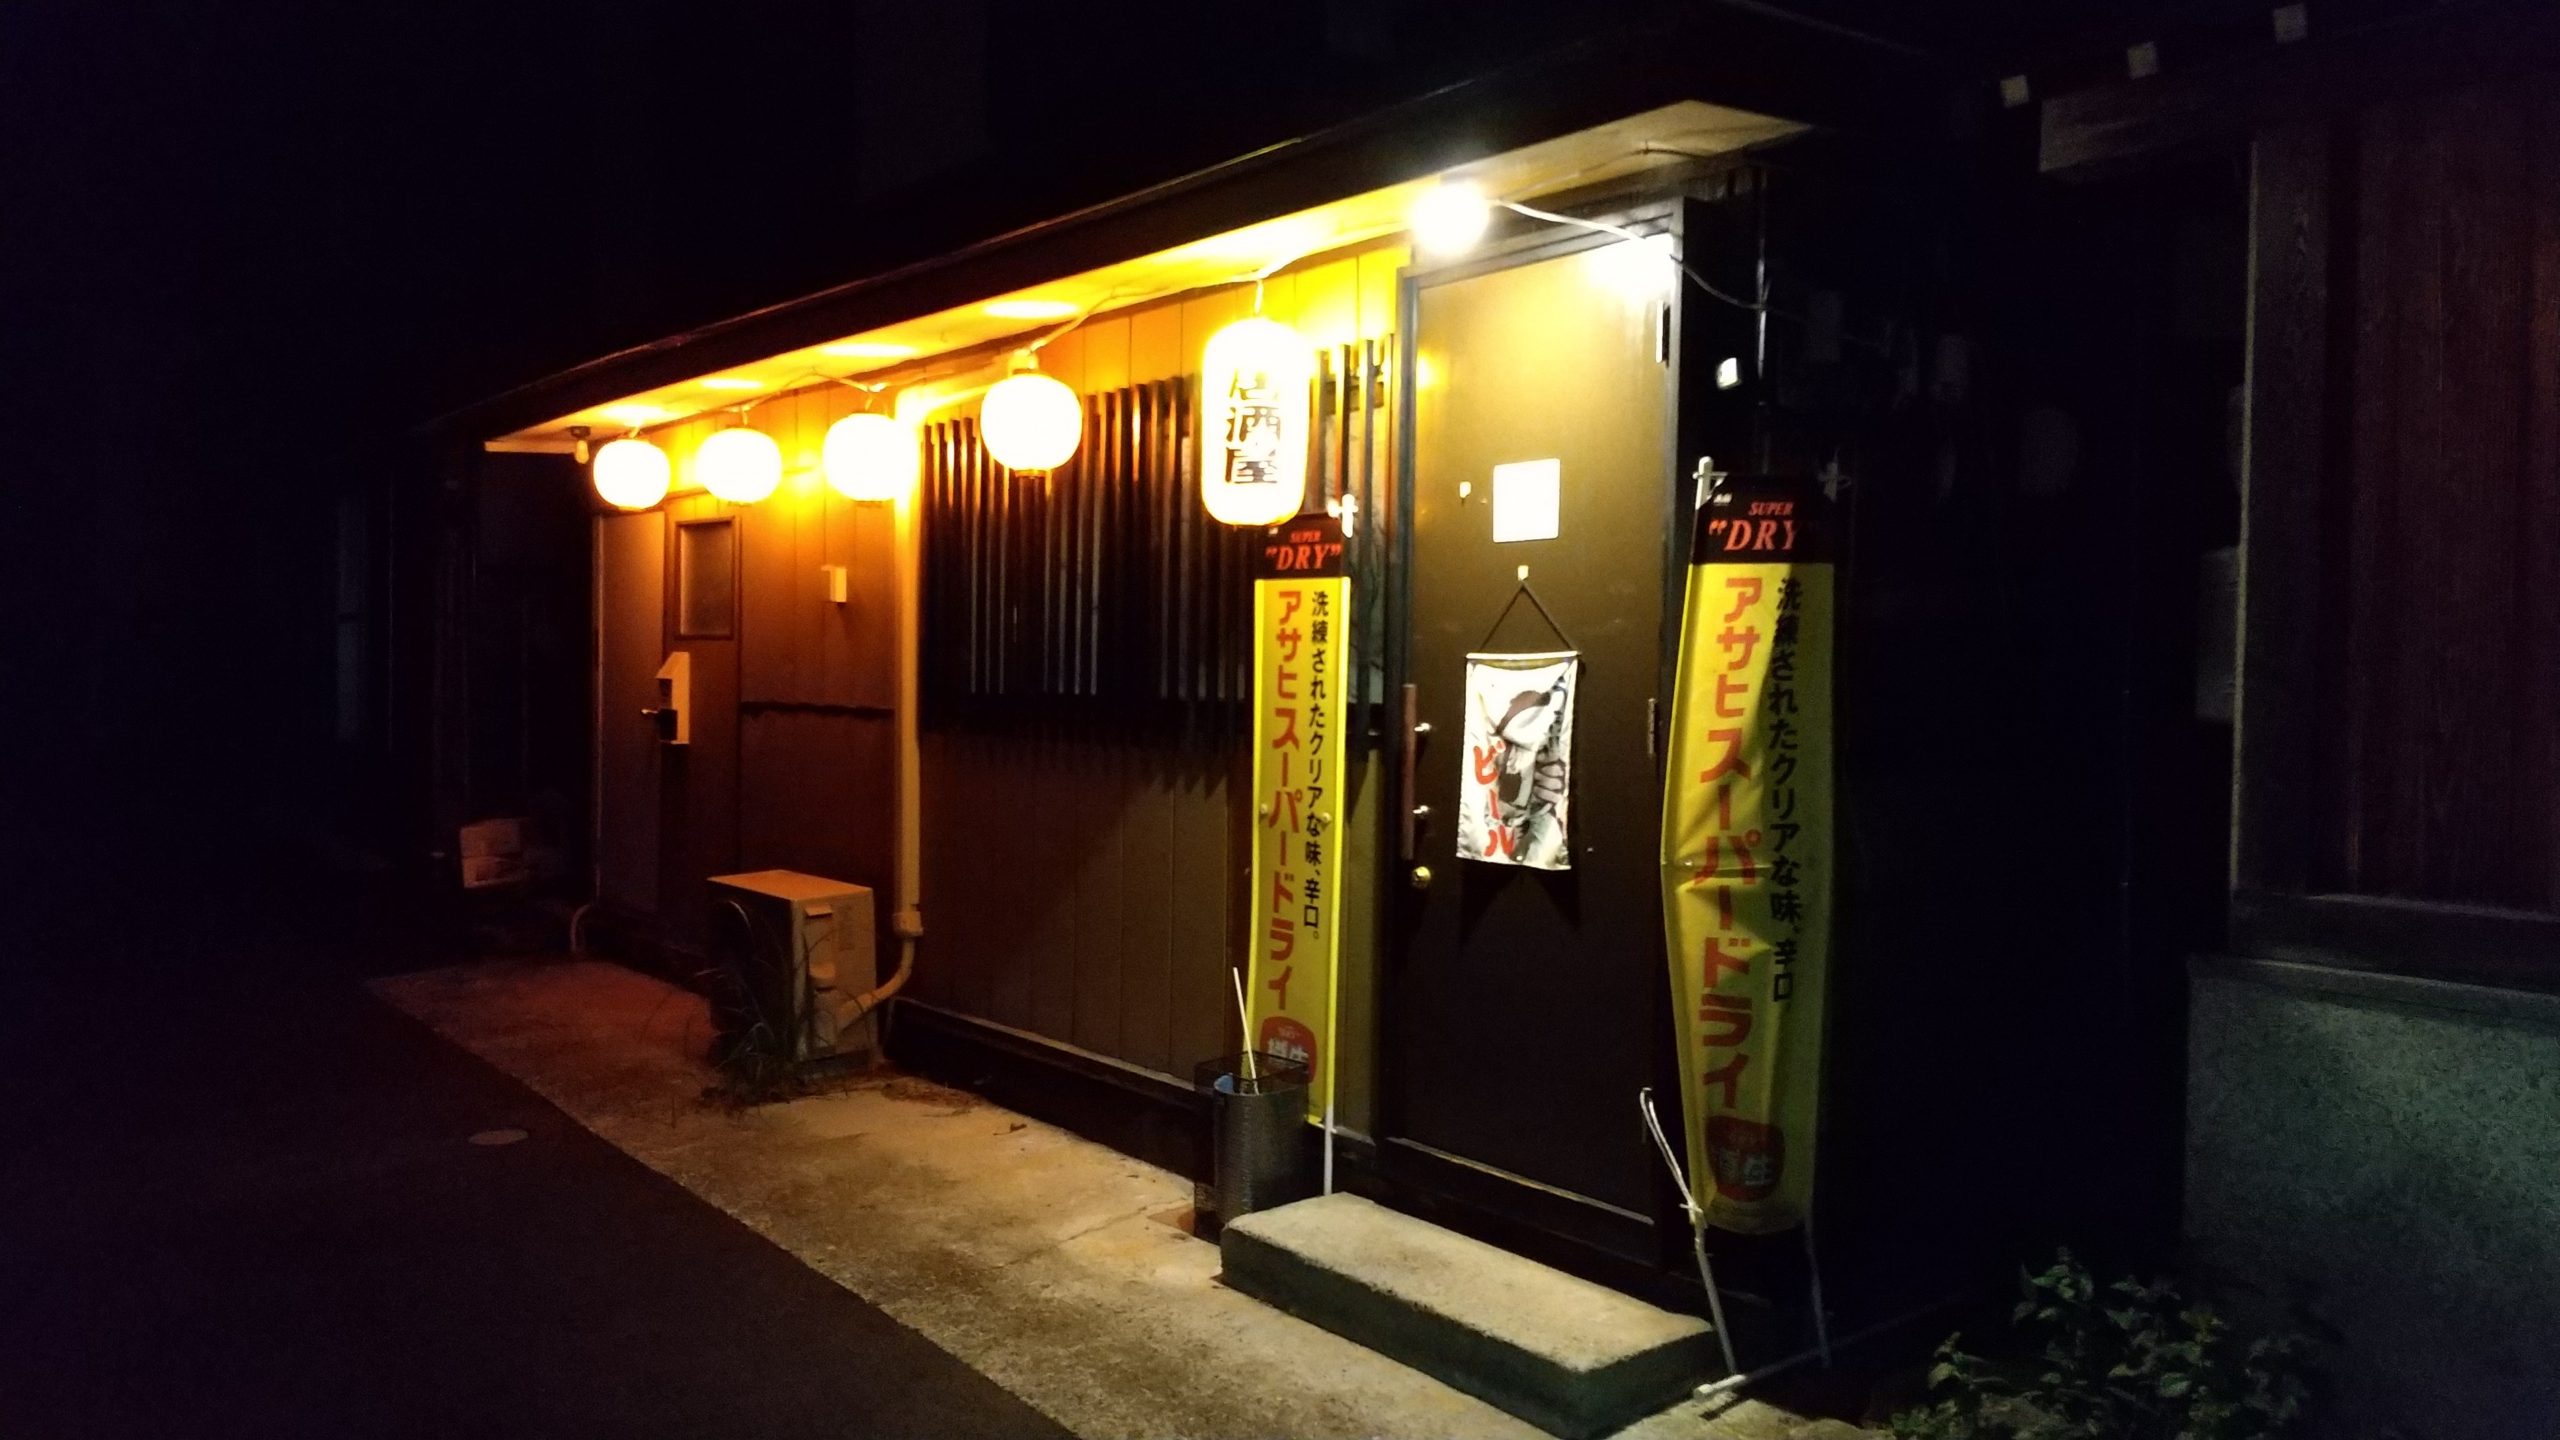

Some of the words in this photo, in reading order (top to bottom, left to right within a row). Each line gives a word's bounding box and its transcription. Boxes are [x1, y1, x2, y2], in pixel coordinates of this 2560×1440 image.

[1225, 367, 1281, 484] 居酒屋
[1747, 501, 1795, 516] SUPER
[1268, 591, 1302, 1010] アサヒスーパードライ
[1473, 739, 1514, 857] ビール
[1694, 577, 1763, 1108] アサヒスーパードライ
